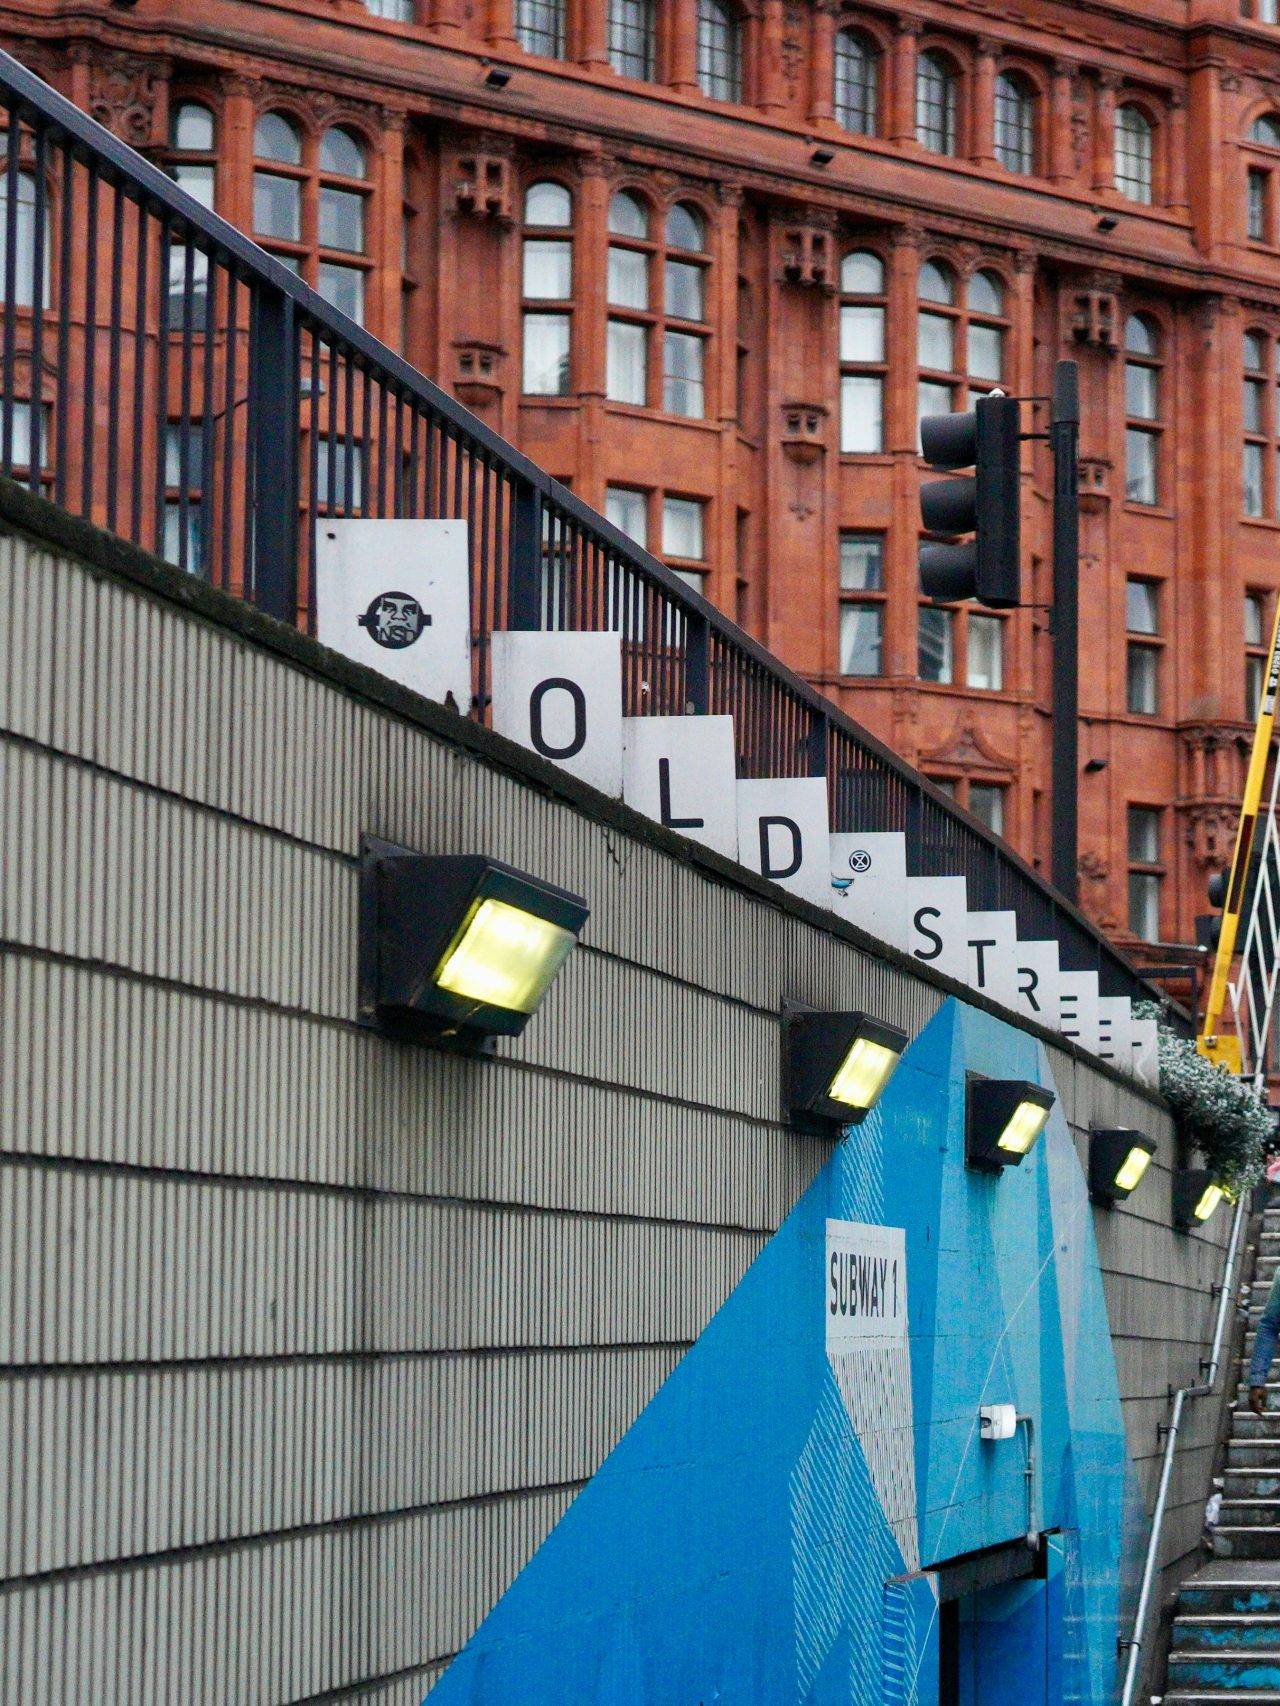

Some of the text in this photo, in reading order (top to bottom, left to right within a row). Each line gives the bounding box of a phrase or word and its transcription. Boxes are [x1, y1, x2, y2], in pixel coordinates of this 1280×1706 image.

[529, 676, 1143, 1059] OLD STREE
[830, 1251, 899, 1318] SUBWAY 1
